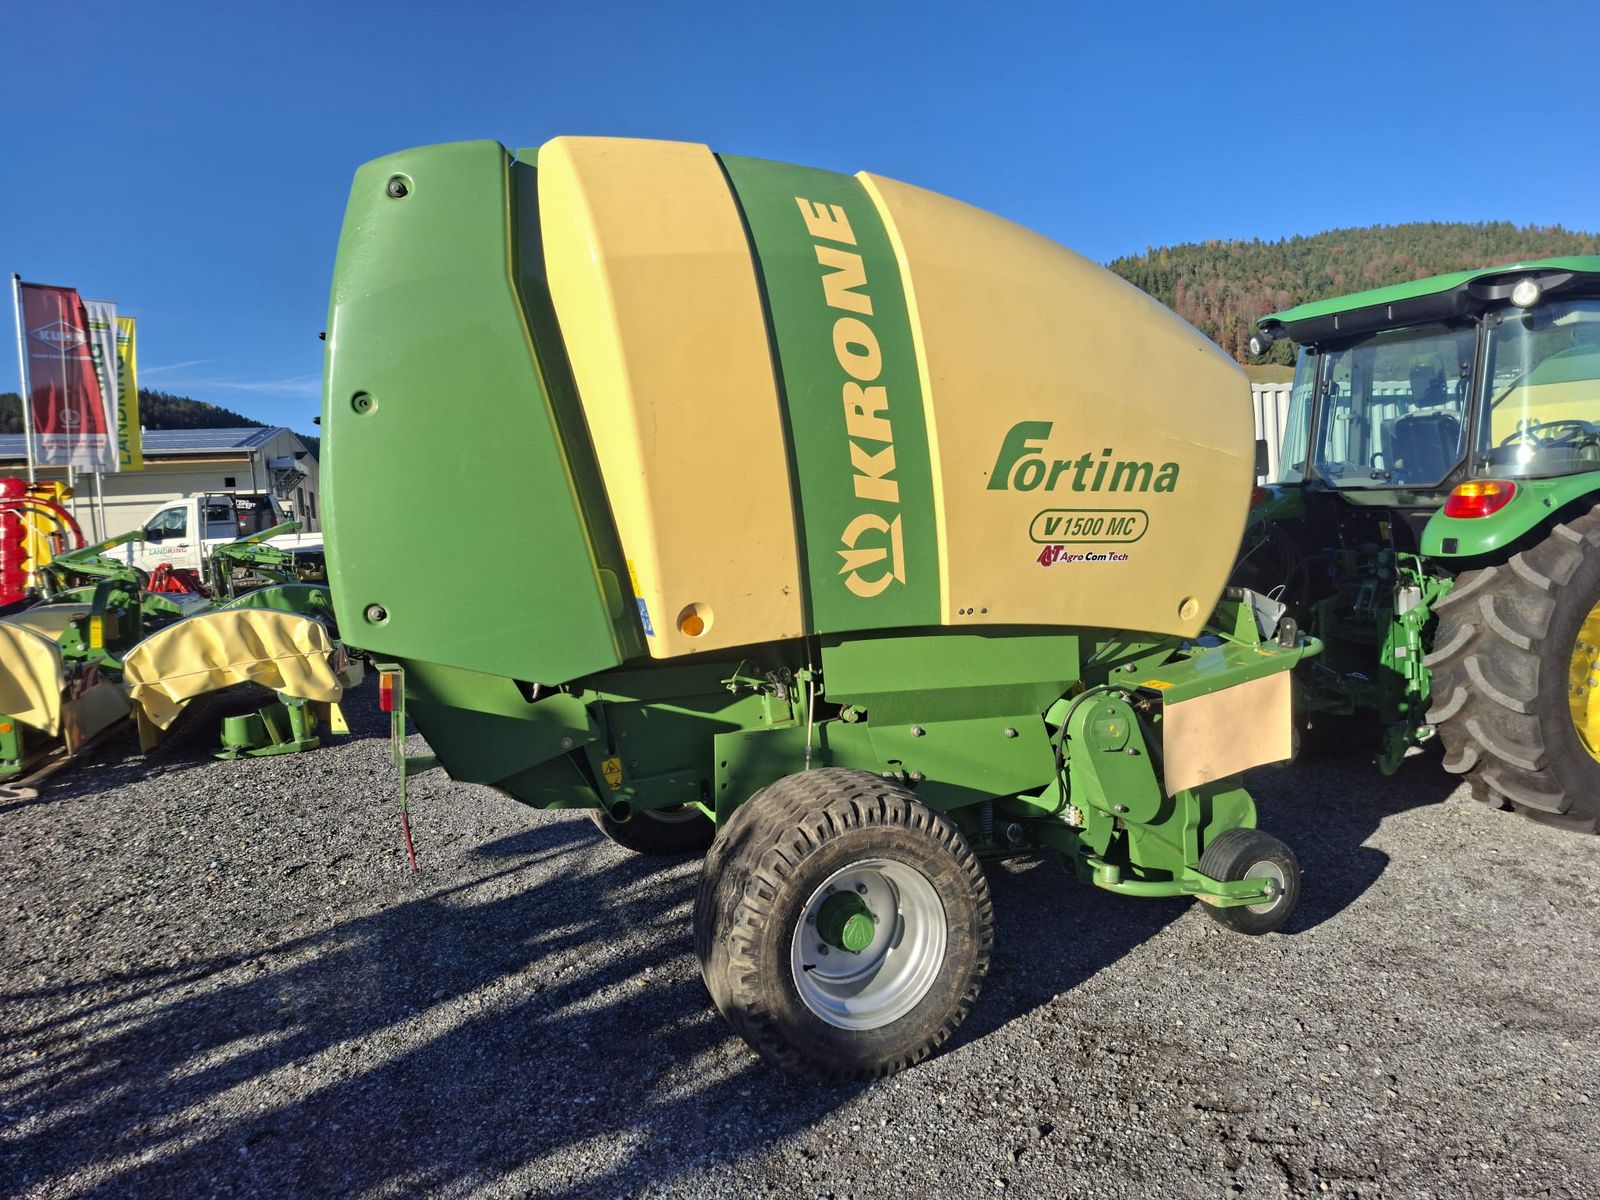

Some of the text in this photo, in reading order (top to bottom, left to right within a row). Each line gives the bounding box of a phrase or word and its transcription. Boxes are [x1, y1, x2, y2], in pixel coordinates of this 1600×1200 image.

[795, 196, 900, 503] KRONE
[987, 421, 1179, 492] Fortima
[1044, 517, 1136, 536] V 1500 MC
[1060, 552, 1083, 562] Agro
[1085, 552, 1106, 561] Com
[1108, 552, 1128, 561] Tech
